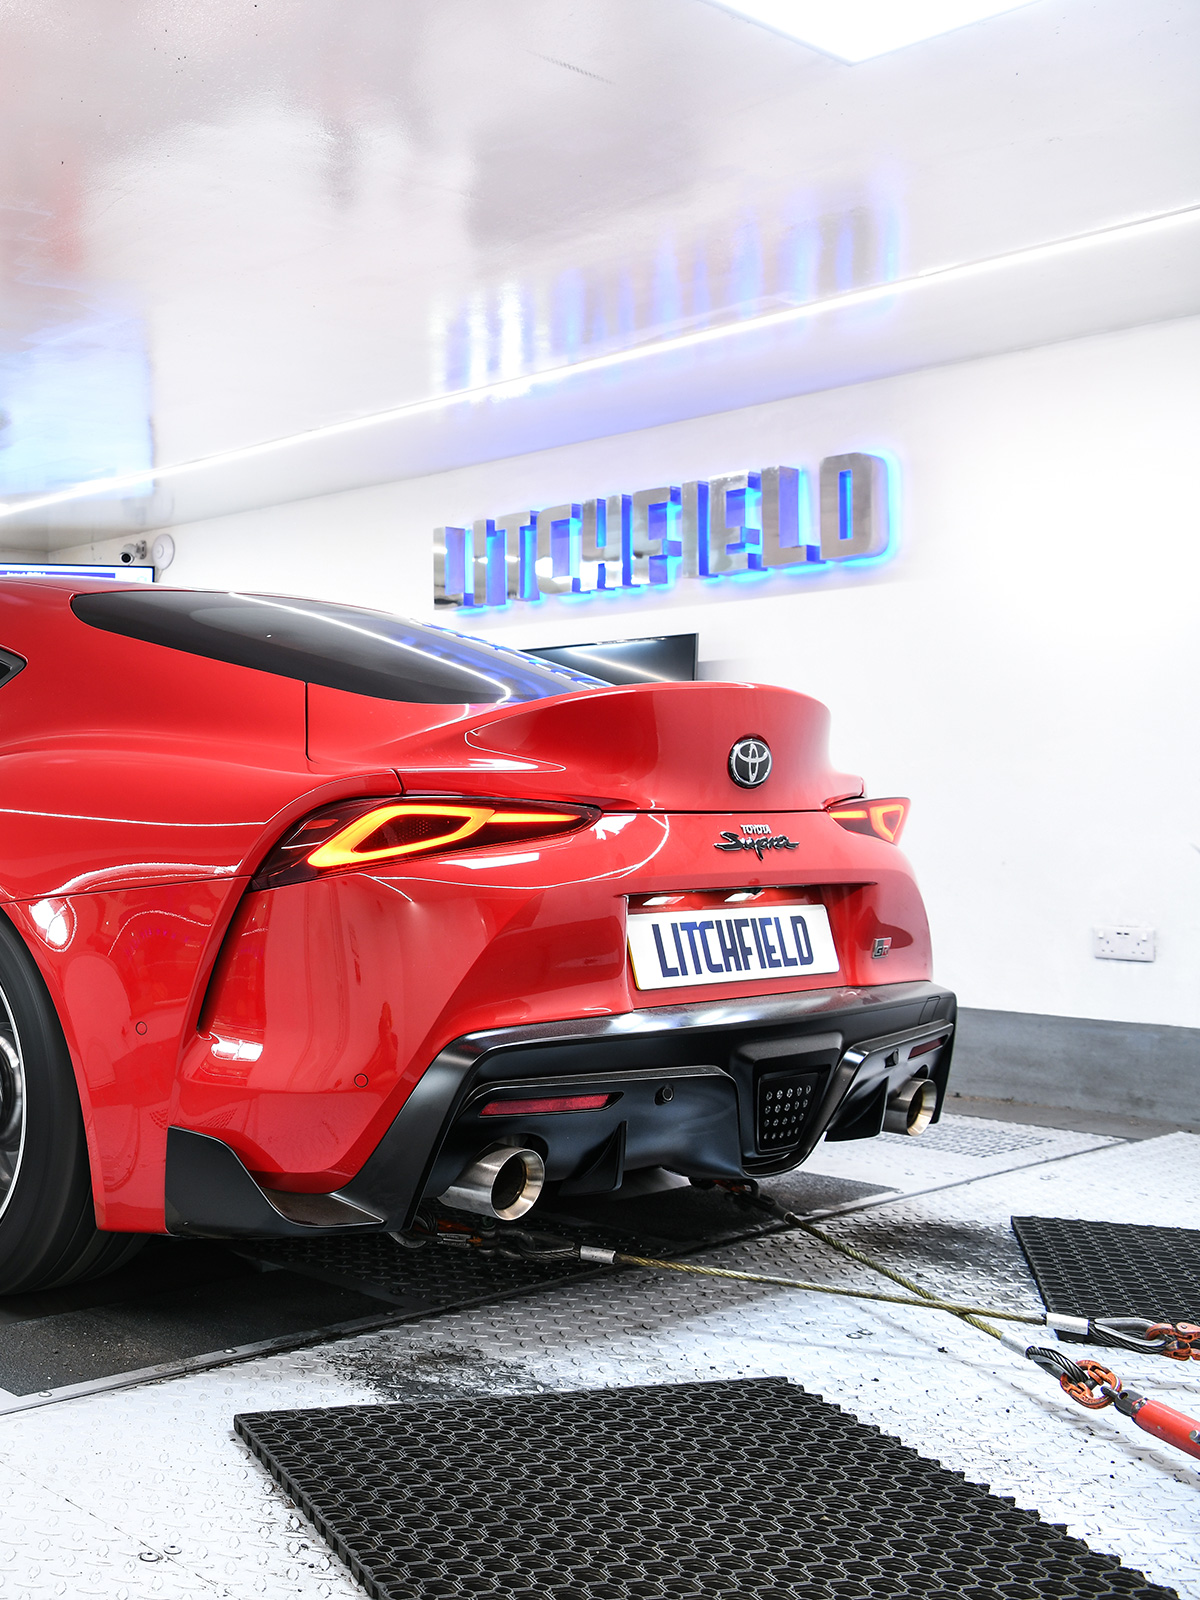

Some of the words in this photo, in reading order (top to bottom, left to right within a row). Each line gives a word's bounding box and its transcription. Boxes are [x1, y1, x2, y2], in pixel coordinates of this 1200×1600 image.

[433, 453, 889, 610] LITCHFIELD
[713, 831, 800, 860] Supra
[740, 824, 772, 834] TOYOTA
[652, 916, 814, 977] LITCHFIELD
